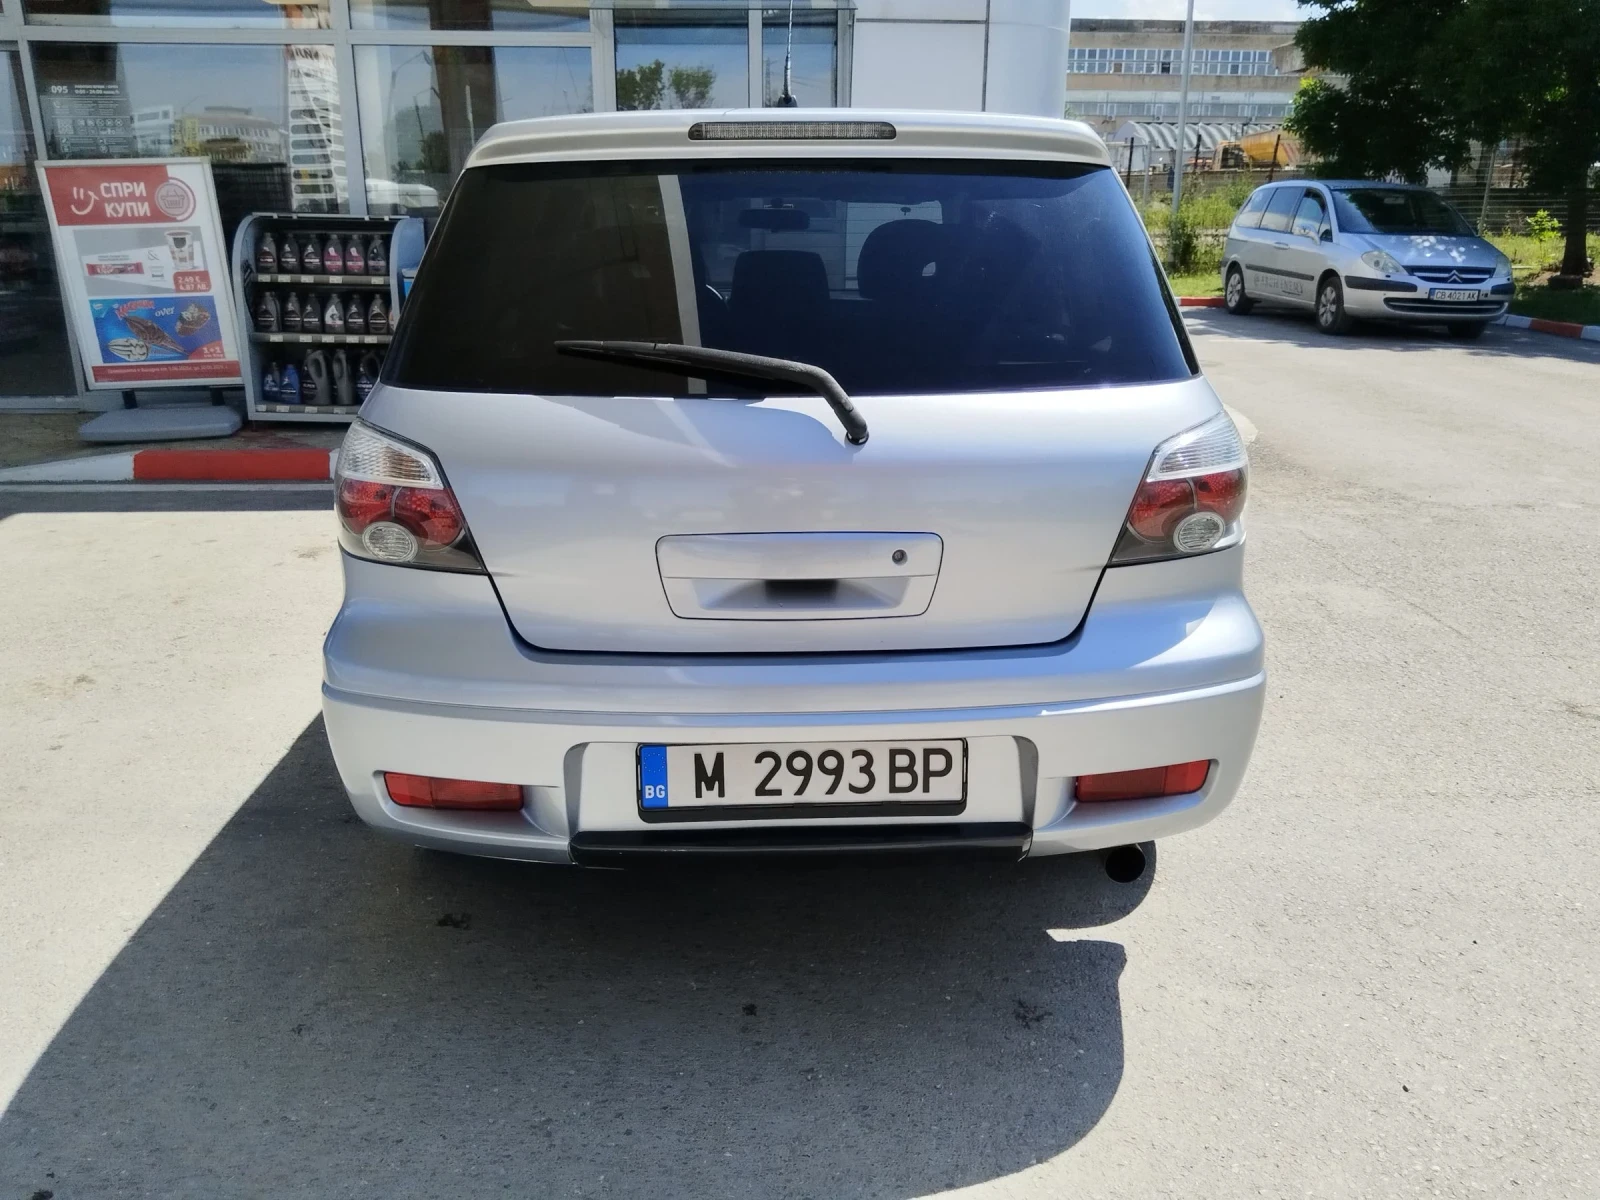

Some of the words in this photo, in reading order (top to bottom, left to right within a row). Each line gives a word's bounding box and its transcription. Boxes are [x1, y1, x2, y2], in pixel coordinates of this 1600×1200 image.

[51, 85, 68, 94] 095
[100, 181, 147, 198] СПРИ
[104, 201, 151, 218] КУПИ
[1435, 290, 1446, 300] CB
[1447, 291, 1465, 300] 4021
[1466, 292, 1477, 300] AK
[154, 306, 175, 317] over
[694, 752, 726, 799] M
[754, 749, 877, 797] 2993
[888, 747, 954, 794] BP
[645, 785, 666, 800] BG
